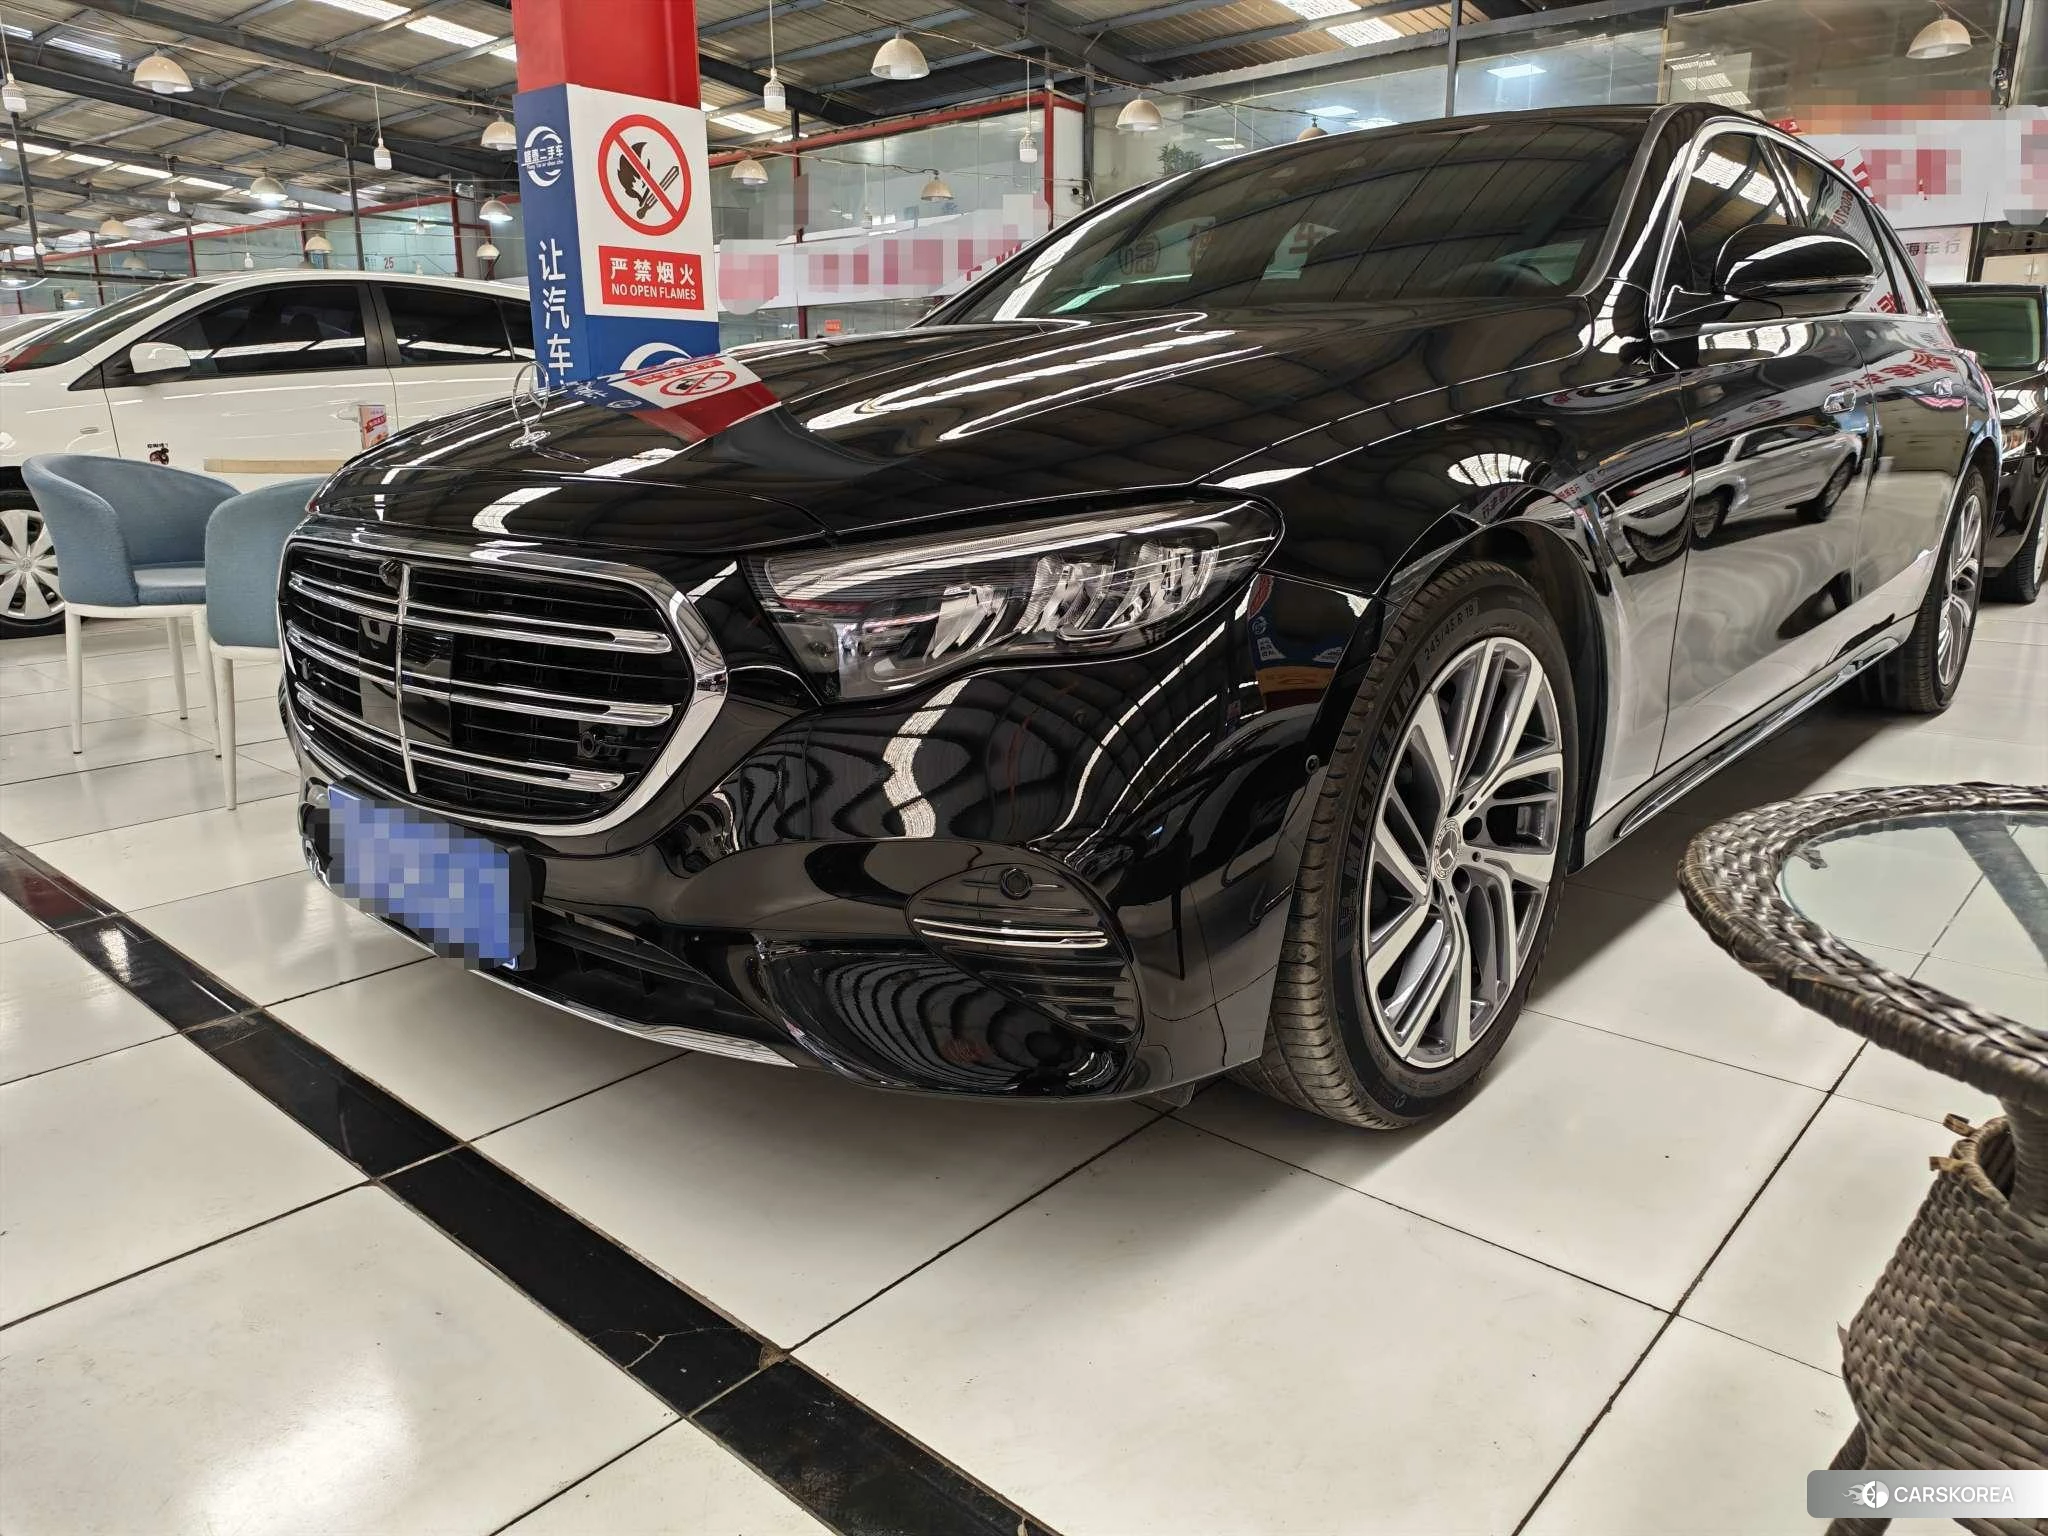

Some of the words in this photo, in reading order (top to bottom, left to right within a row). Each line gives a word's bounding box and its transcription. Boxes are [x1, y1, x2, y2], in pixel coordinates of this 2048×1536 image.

[609, 257, 696, 287] 严禁烟火
[611, 282, 628, 297] NO
[629, 283, 658, 299] OPEN
[659, 286, 697, 301] FLAMES
[538, 238, 574, 377] 让汽车
